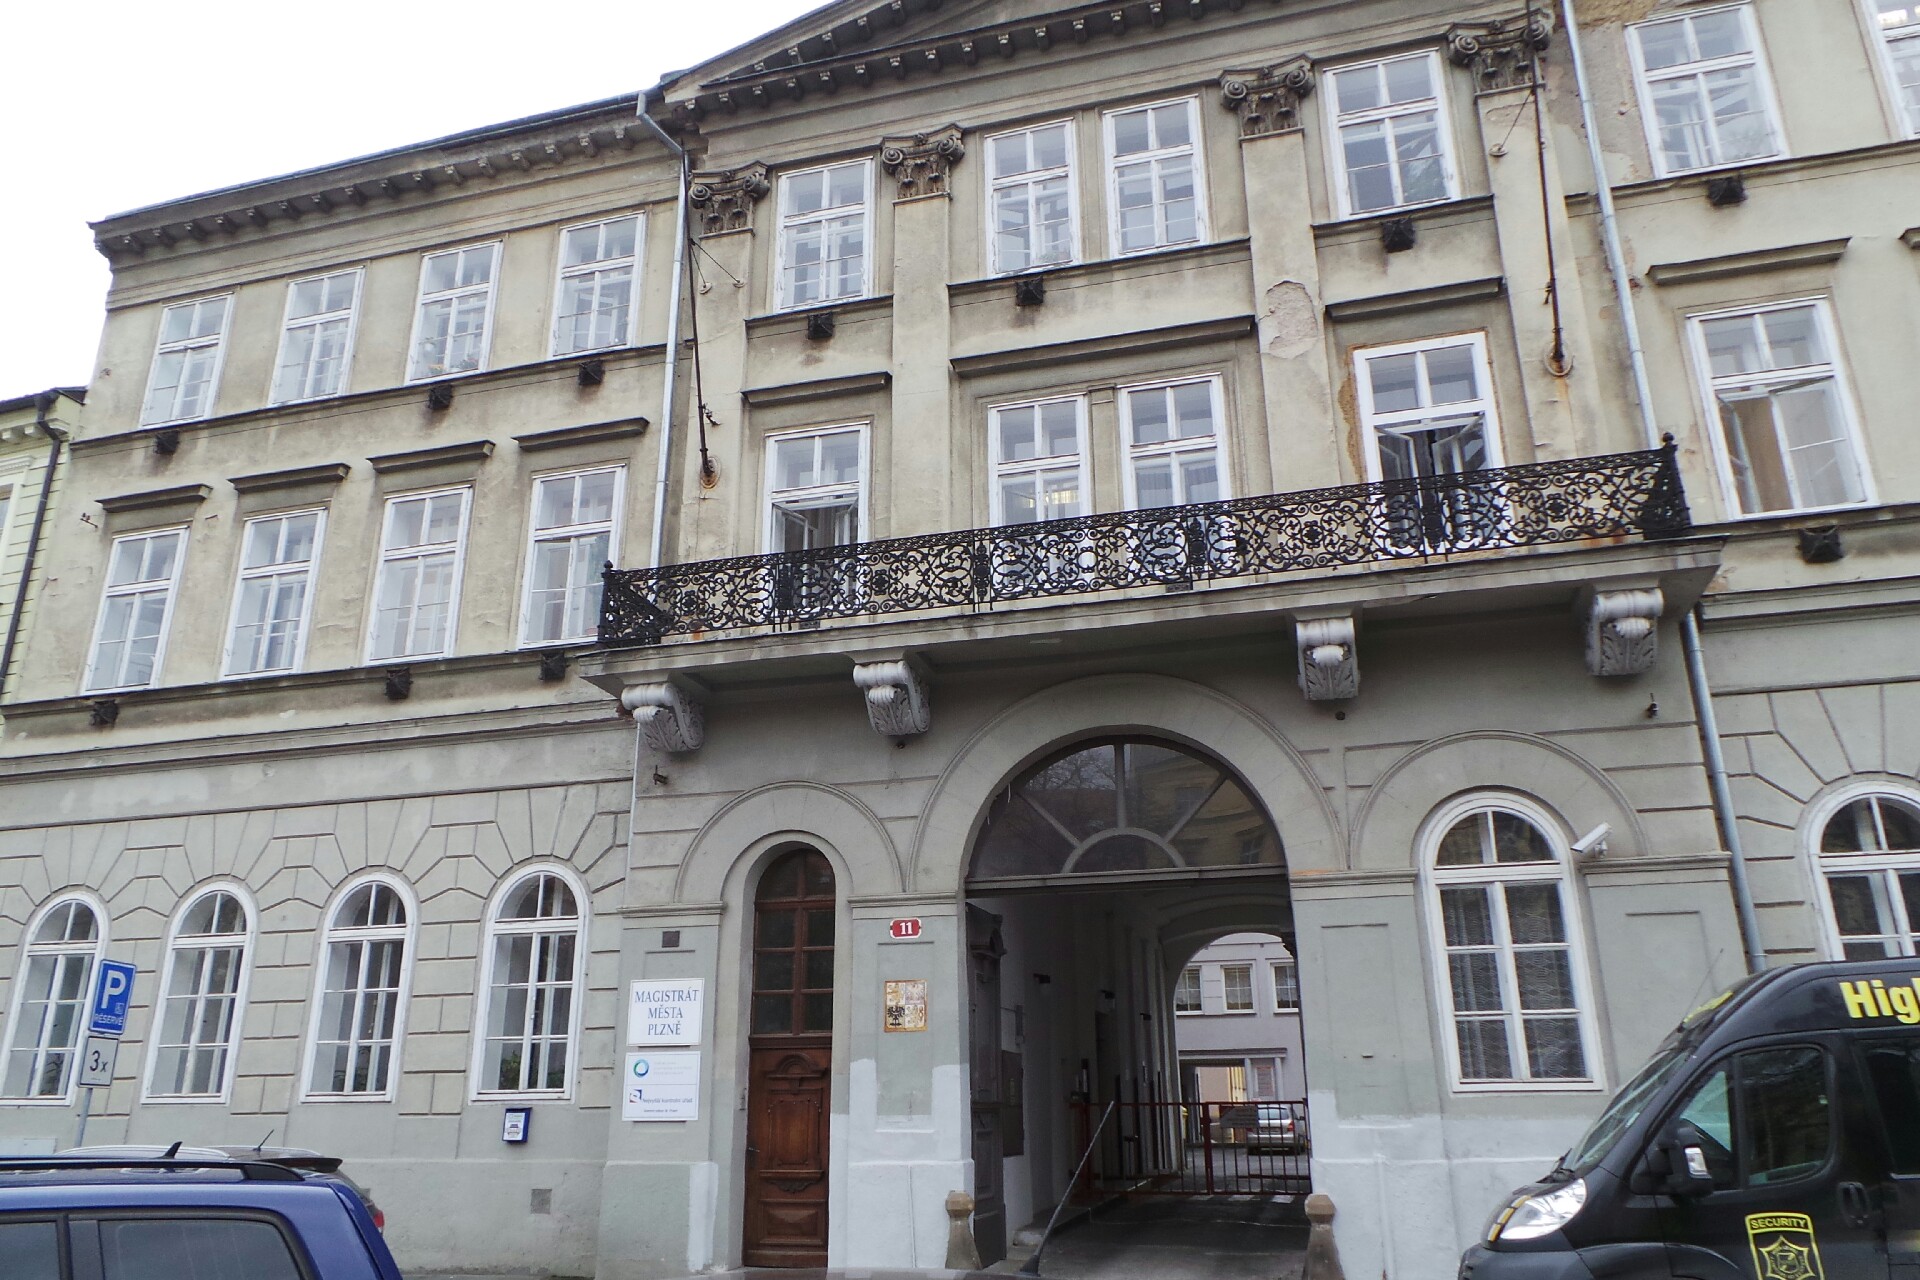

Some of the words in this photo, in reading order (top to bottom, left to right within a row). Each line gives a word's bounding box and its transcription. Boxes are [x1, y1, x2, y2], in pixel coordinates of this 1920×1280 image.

[899, 921, 913, 935] 11
[100, 969, 127, 1009] P
[634, 986, 699, 1003] MAGISTRÁT
[1839, 977, 1920, 1024] Hig
[647, 1004, 684, 1019] MĚSTA
[647, 1020, 682, 1036] PLZNĚ
[1750, 1217, 1806, 1229] SECURITY
